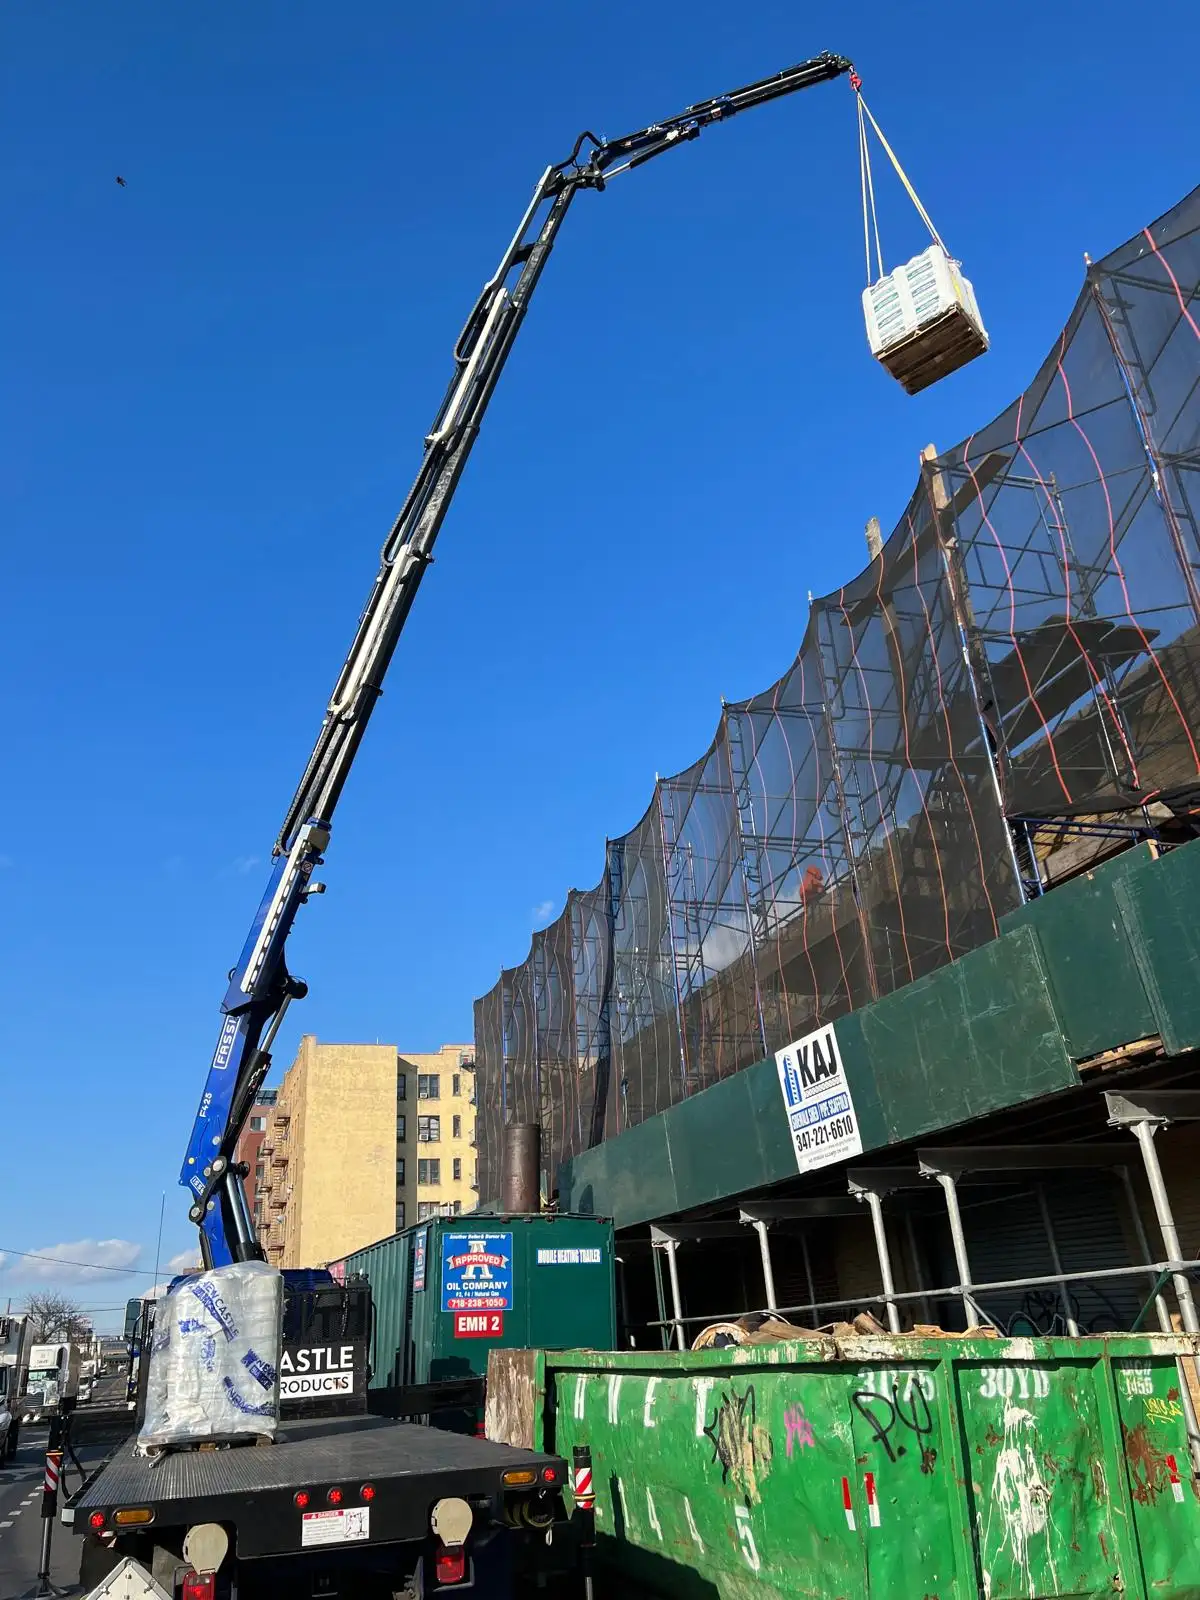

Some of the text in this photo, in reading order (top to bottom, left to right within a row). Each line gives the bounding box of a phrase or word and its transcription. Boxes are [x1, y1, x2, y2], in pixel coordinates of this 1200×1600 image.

[217, 1018, 237, 1065] FASSI
[796, 1033, 838, 1088] KAJ
[199, 1093, 213, 1118] F425
[796, 1115, 854, 1152] 347-221-6610
[455, 1254, 501, 1266] APPROVED
[579, 1249, 601, 1263] TRAILER
[446, 1281, 508, 1291] OIL COMPANY
[451, 1298, 504, 1308] 718-238-1050
[458, 1316, 500, 1332] EMH 2
[980, 1363, 1050, 1398] 30YD
